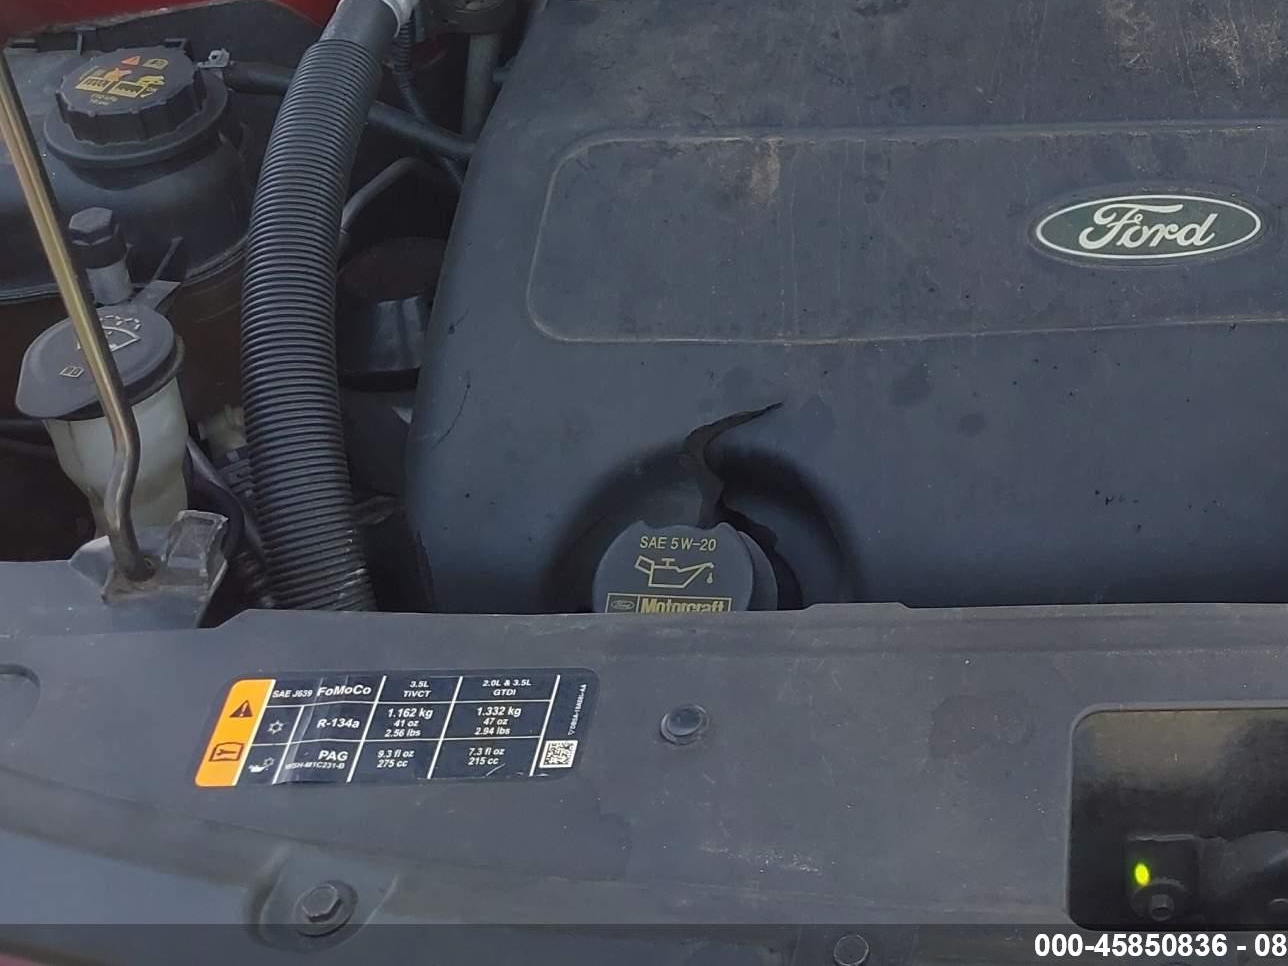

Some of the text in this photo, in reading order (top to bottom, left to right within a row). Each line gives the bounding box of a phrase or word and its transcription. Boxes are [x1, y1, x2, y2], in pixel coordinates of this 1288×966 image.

[1078, 204, 1218, 250] Ford
[640, 536, 717, 551] SAE 5W-20
[640, 597, 724, 613] Motorcraft
[409, 680, 430, 688] 3.5L
[482, 679, 532, 687] 2.0L & 3.5L
[272, 689, 313, 698] SAE J639
[317, 684, 372, 697] FoMoCo
[493, 688, 517, 696] GTDI
[388, 707, 434, 719] 1.162 kg
[477, 706, 522, 717] 1.332 kg
[317, 717, 361, 729] R-134a
[394, 719, 406, 727] 41
[483, 717, 495, 725] 47
[384, 728, 421, 738] 2.56 lbs
[474, 726, 511, 735] 2.94 lbs
[318, 750, 349, 762] PAG
[377, 749, 415, 758] 9.3 fl oz
[468, 747, 483, 756] 7.3
[484, 747, 492, 756] fl
[377, 759, 409, 768] 275 cc
[468, 757, 499, 765] 215 cc
